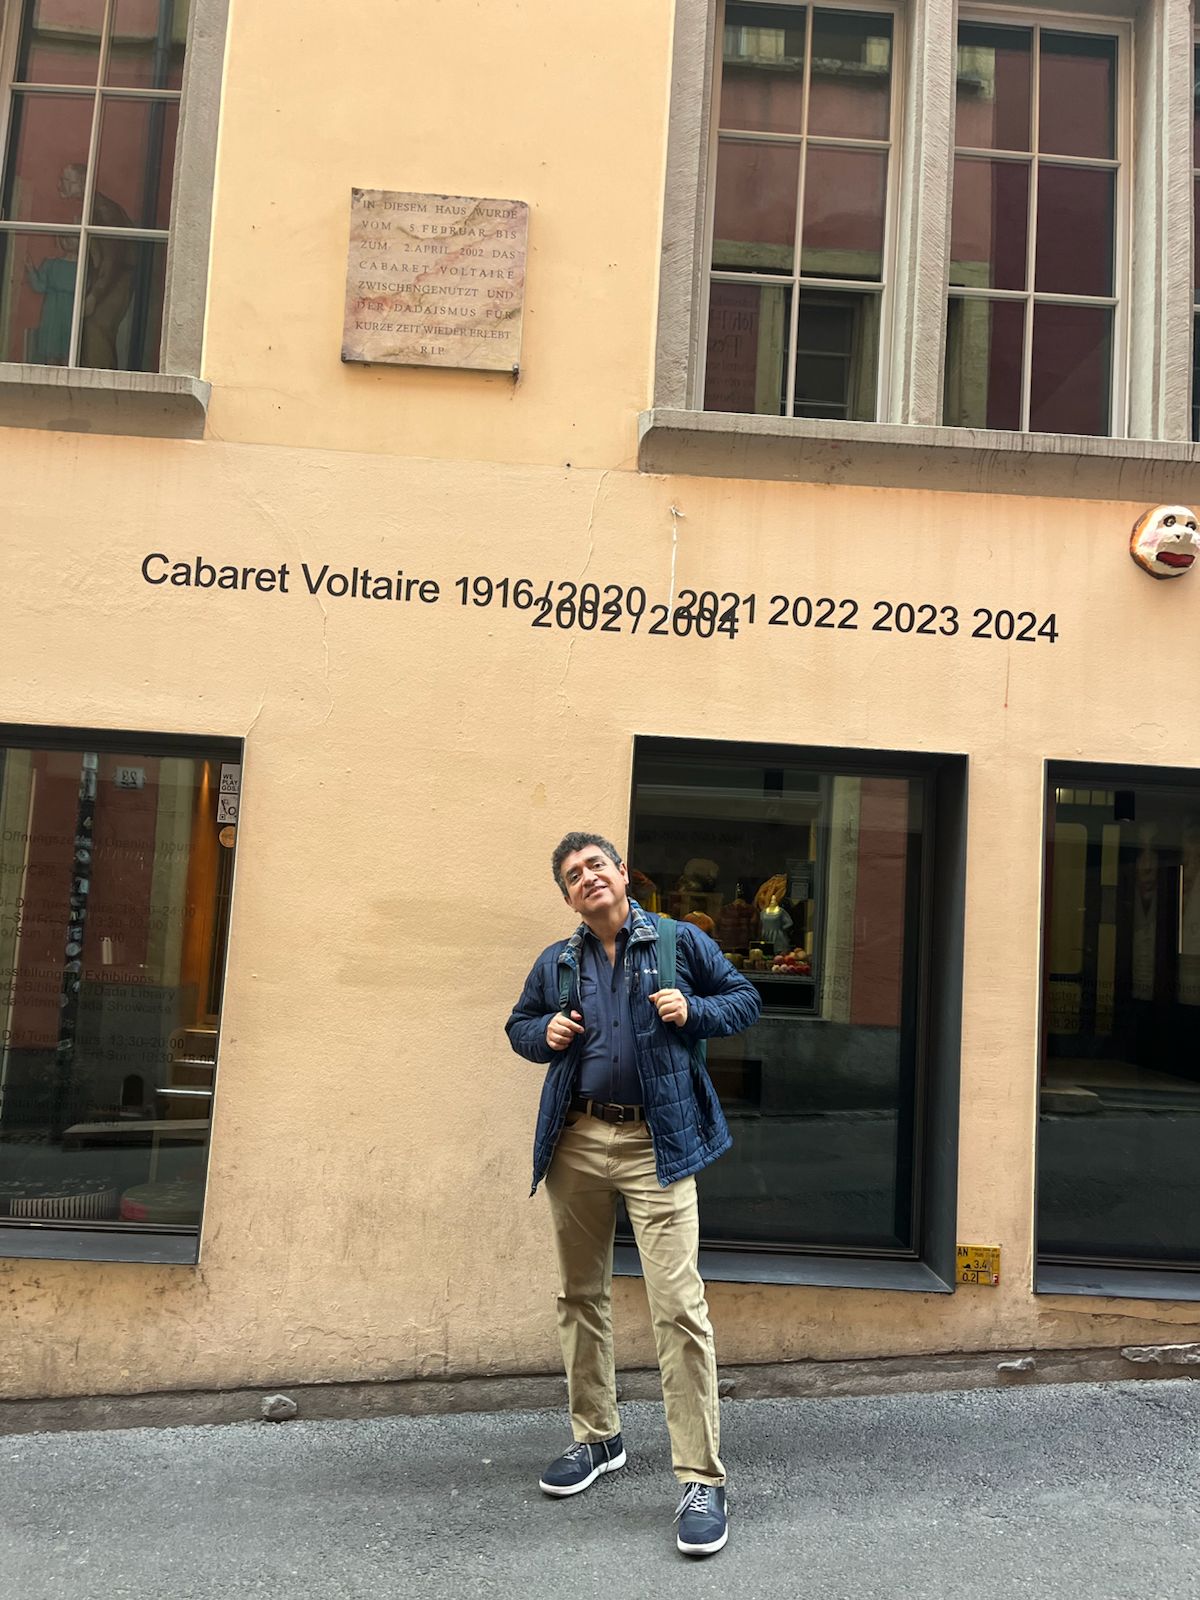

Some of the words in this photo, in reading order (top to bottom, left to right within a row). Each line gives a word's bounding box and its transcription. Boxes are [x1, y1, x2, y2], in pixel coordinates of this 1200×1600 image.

[363, 200, 375, 209] IN
[384, 202, 427, 213] DIESEM
[435, 205, 467, 216] HAUS
[475, 207, 518, 219] WURDE
[361, 220, 392, 231] VOM
[496, 230, 517, 240] BIS
[360, 240, 388, 251] ZUM
[460, 247, 484, 257] 2002
[492, 249, 516, 259] DAS
[359, 260, 430, 274] CABARET
[440, 266, 515, 280] VOLTAIRE
[358, 281, 479, 297] ZWISCHENGENUTZT
[487, 290, 514, 300] UND
[357, 300, 385, 312] DER
[394, 303, 477, 318] DADAISMUS
[355, 321, 393, 332] KURZE
[396, 324, 420, 334] ZEIT
[423, 325, 467, 337] WIEDER
[469, 328, 512, 340] ERLEBT
[142, 553, 290, 593] Cabaret
[302, 564, 440, 604] Voltaire
[677, 590, 756, 624] 2021
[769, 595, 859, 630] 2022
[872, 601, 959, 636] 2023
[972, 608, 1059, 643] 2024
[962, 1272, 976, 1283] 0.2
